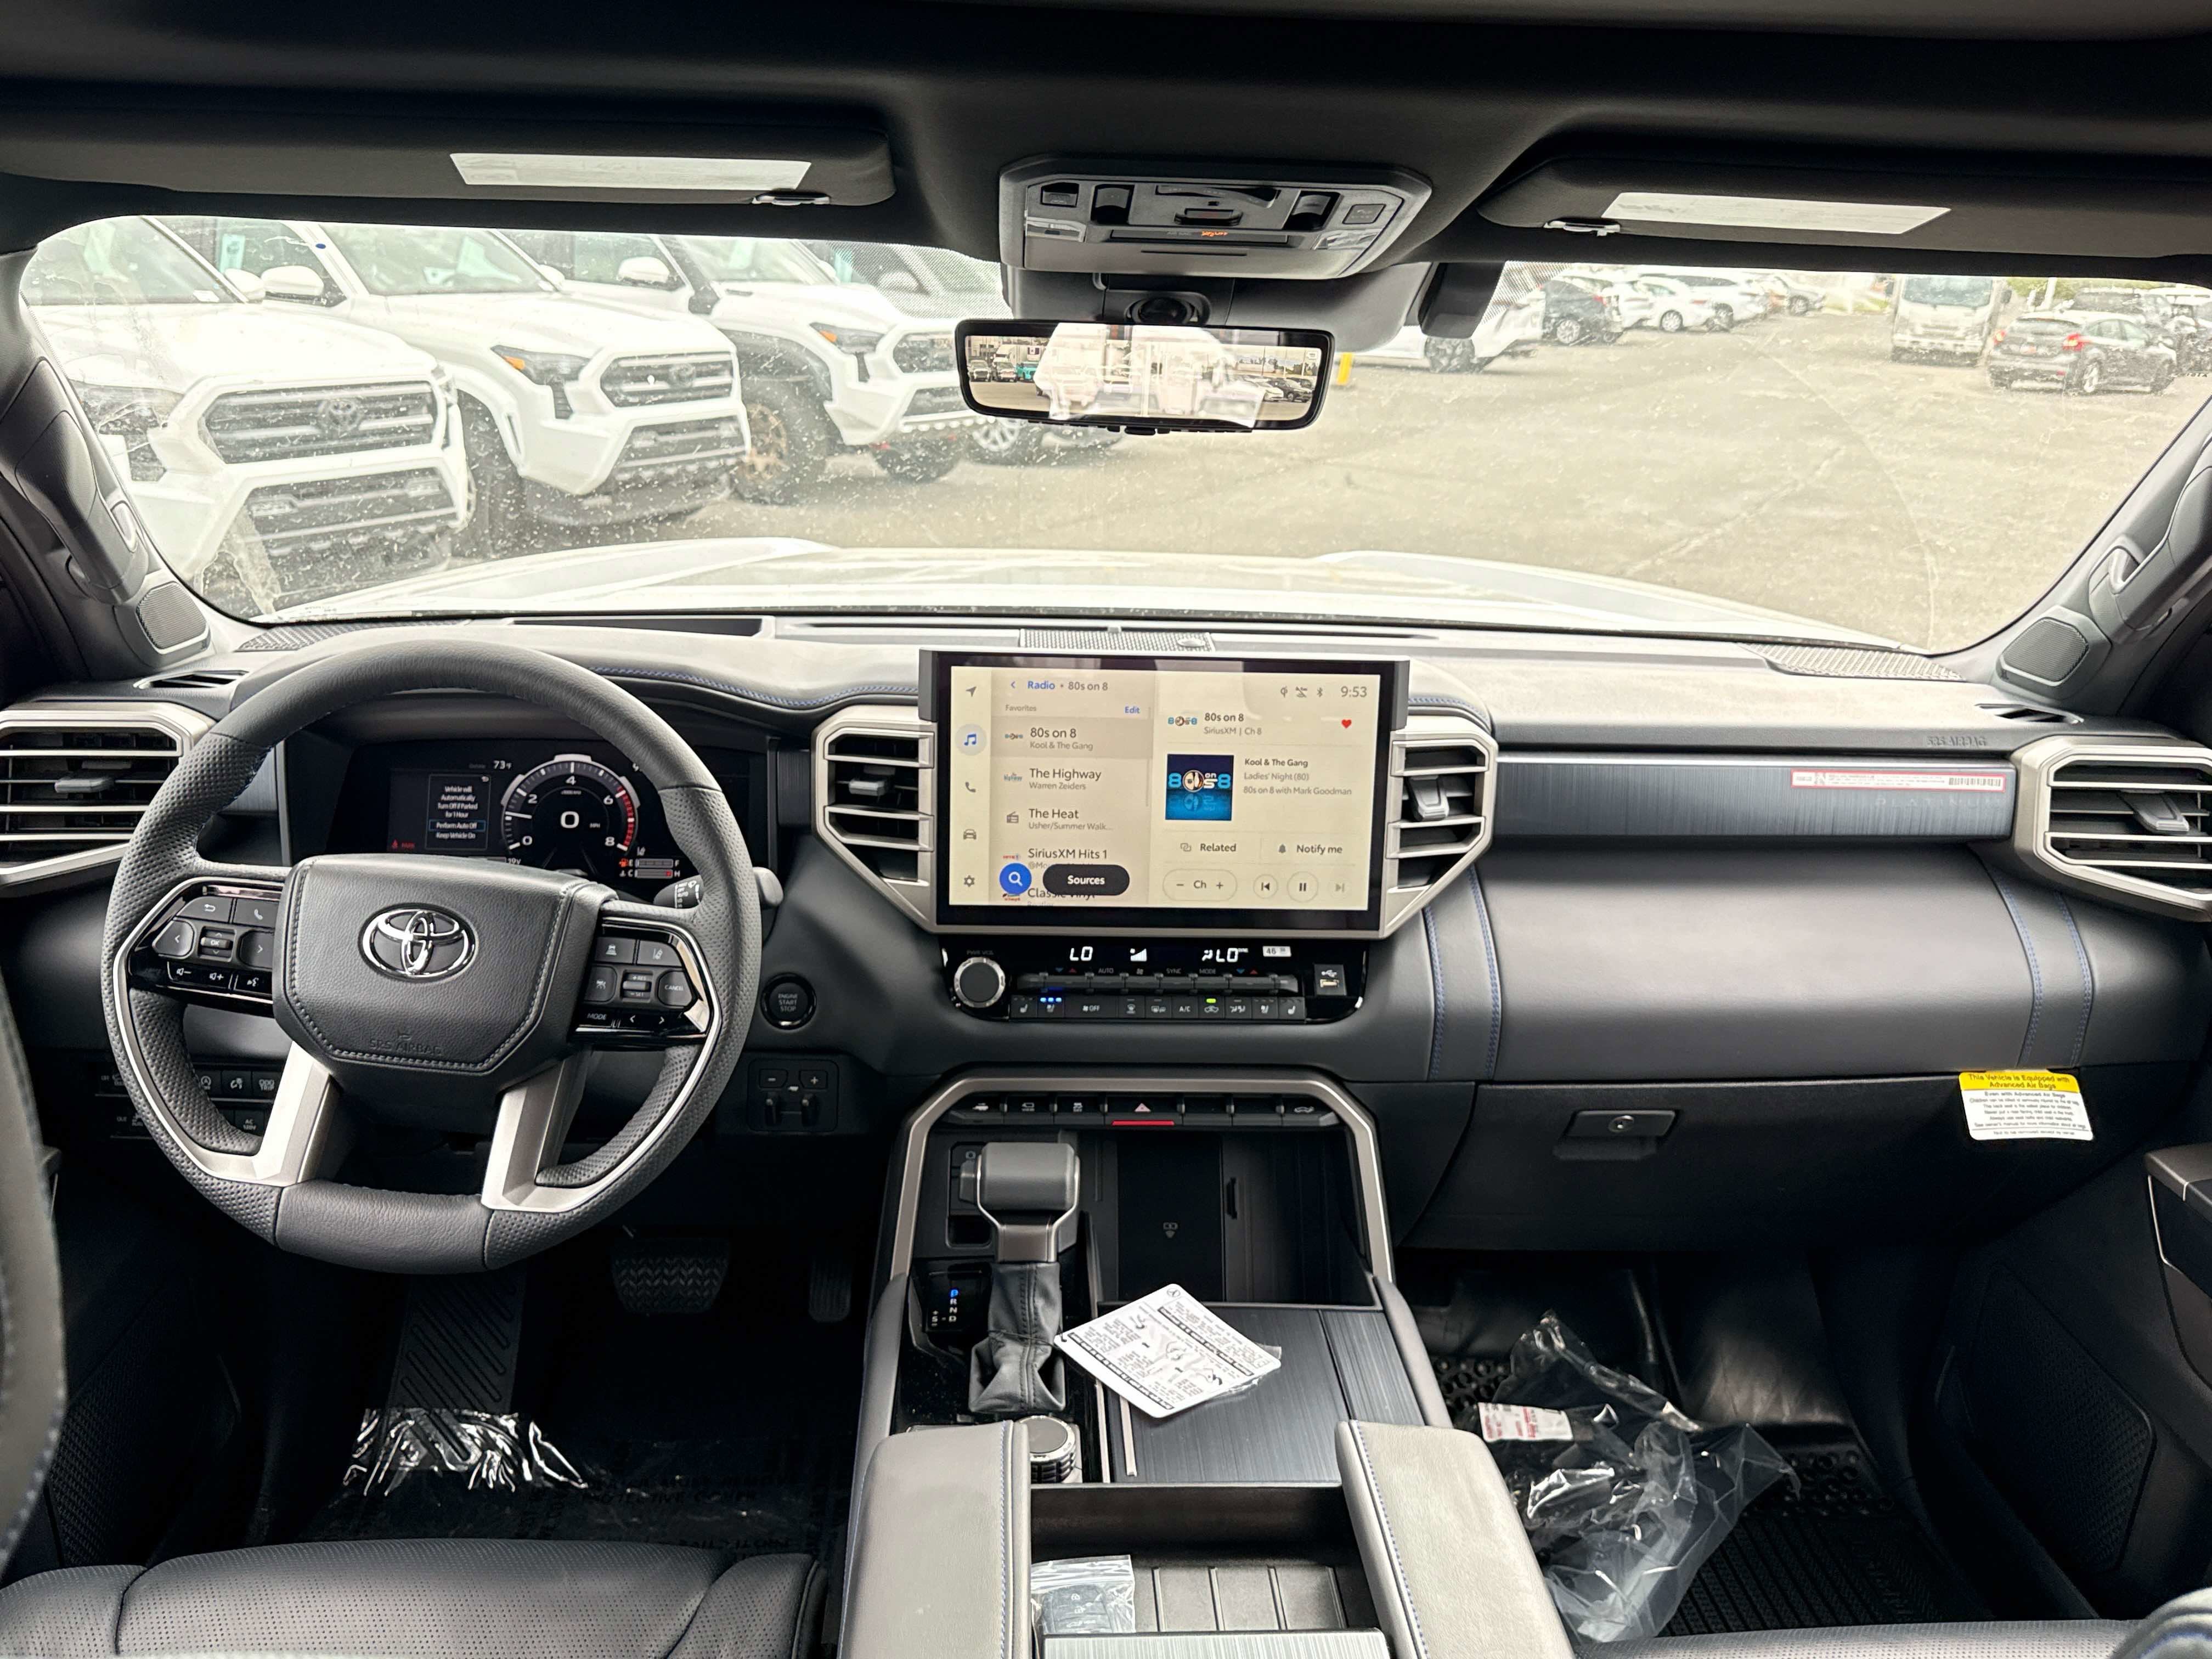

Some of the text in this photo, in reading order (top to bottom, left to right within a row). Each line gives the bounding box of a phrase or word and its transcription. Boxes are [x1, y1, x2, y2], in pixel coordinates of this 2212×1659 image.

[1028, 681, 1055, 690] Radio
[1069, 682, 1085, 690] 80s
[1341, 686, 1367, 697] 9:53
[1205, 713, 1221, 721] 80s
[1238, 714, 1244, 722] 8
[1030, 728, 1049, 737] 80s
[1070, 729, 1076, 737] 8
[1073, 742, 1093, 751] Gang
[1288, 759, 1308, 768] Gang
[1030, 769, 1049, 778] The
[1053, 769, 1101, 781] Highway
[1272, 773, 1293, 782] Night
[566, 776, 576, 786] 4
[528, 794, 537, 803] 2
[603, 795, 613, 805] 6
[1029, 809, 1079, 819] The Heat
[561, 811, 579, 828] 0
[522, 836, 533, 845] 0
[605, 837, 614, 846] 8
[1029, 849, 1075, 859] SiriusXM
[1079, 849, 1099, 859] Hits
[1103, 850, 1107, 858] 1
[1297, 845, 1325, 855] Notify
[629, 859, 634, 867] E
[628, 869, 634, 877] C
[1068, 875, 1105, 884] Sources
[1194, 880, 1206, 888] Ch
